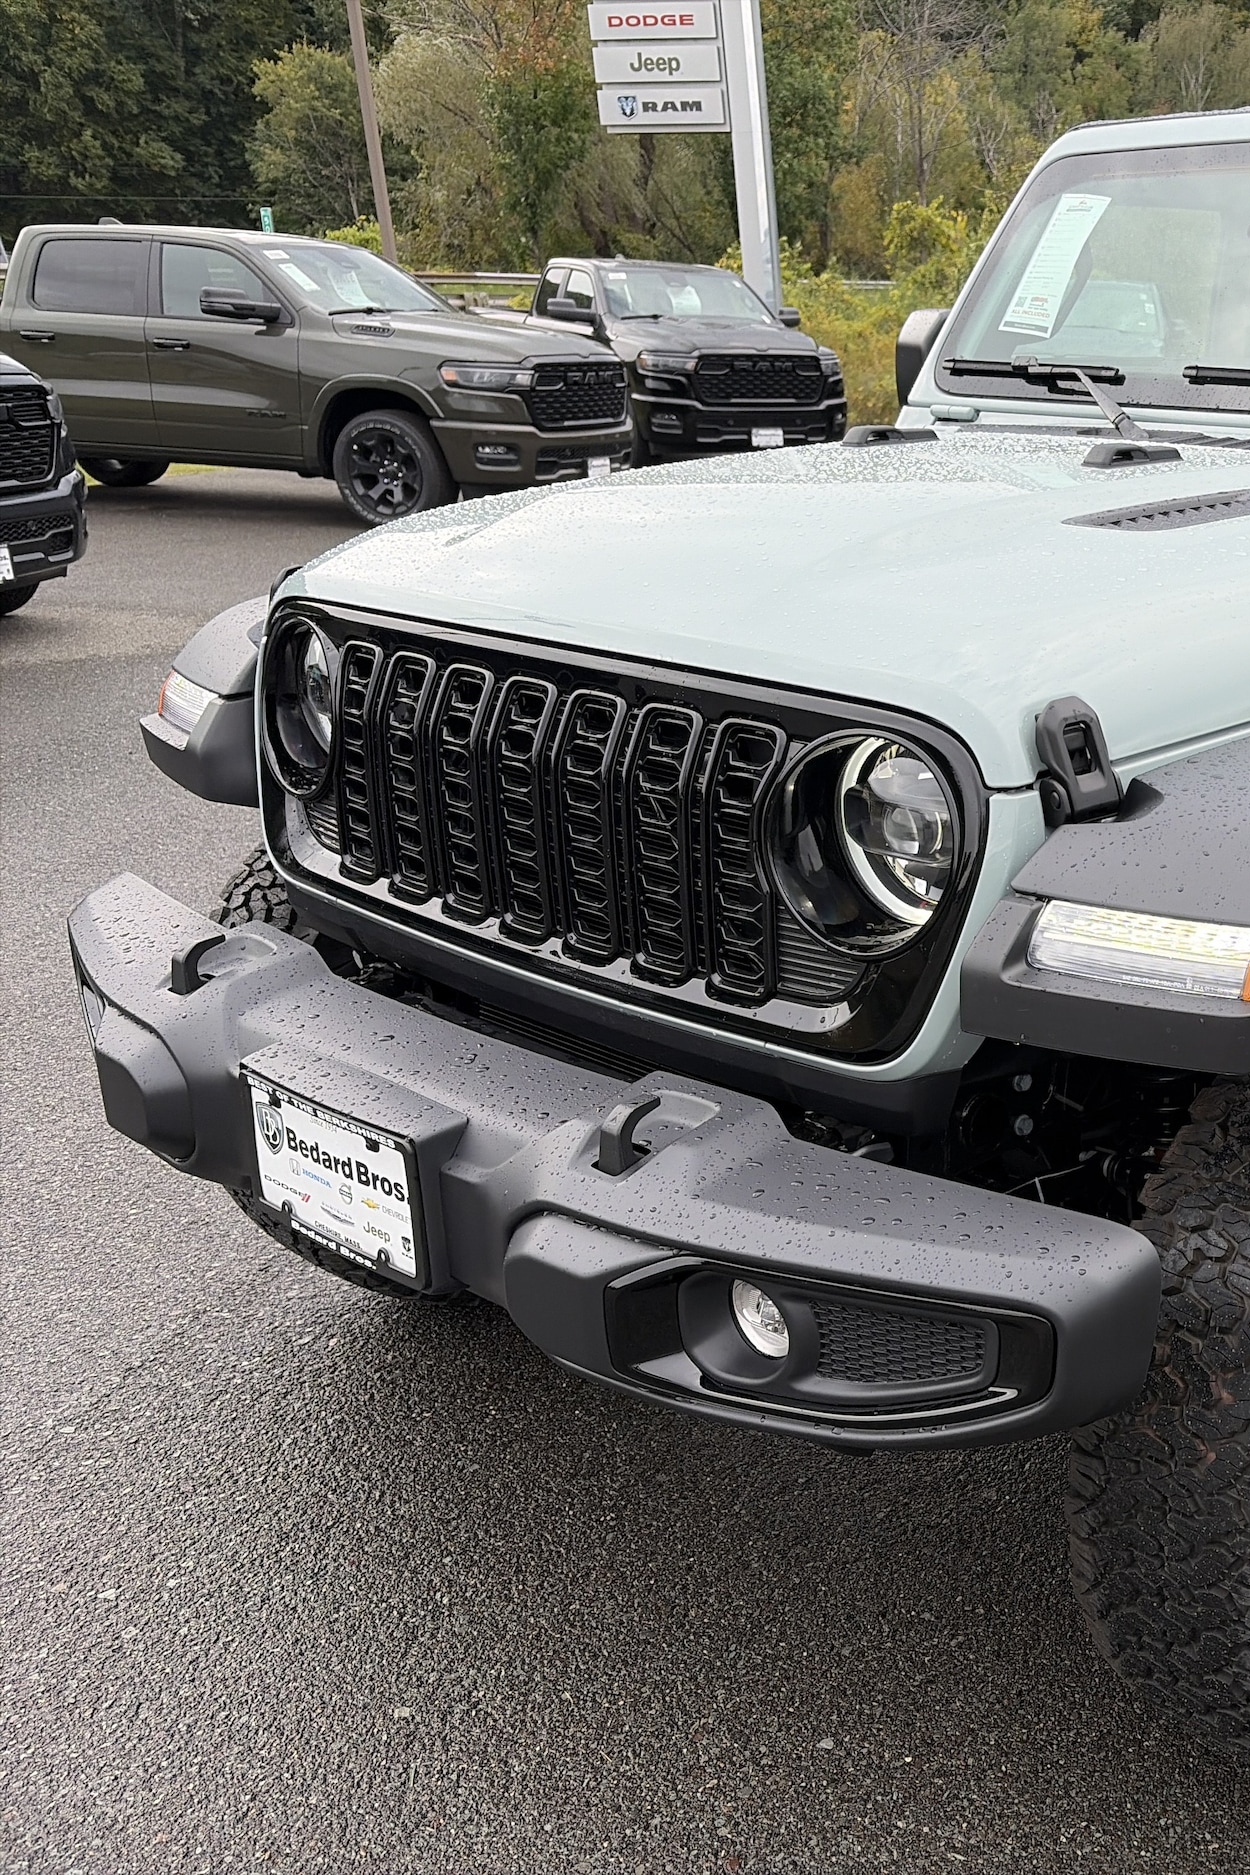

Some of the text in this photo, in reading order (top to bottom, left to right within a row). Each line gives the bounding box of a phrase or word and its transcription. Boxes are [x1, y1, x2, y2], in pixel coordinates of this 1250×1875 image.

[607, 14, 695, 28] DODGE
[629, 52, 681, 75] Jeep
[641, 100, 703, 112] RAM
[246, 1075, 396, 1149] BEST OF THE BERKSHIRES
[285, 1126, 354, 1181] Bedard
[264, 1174, 306, 1198] DODGE
[302, 1168, 333, 1189] HONDA
[362, 1221, 391, 1244] Jeep
[290, 1219, 377, 1270] Bedard Bros.
